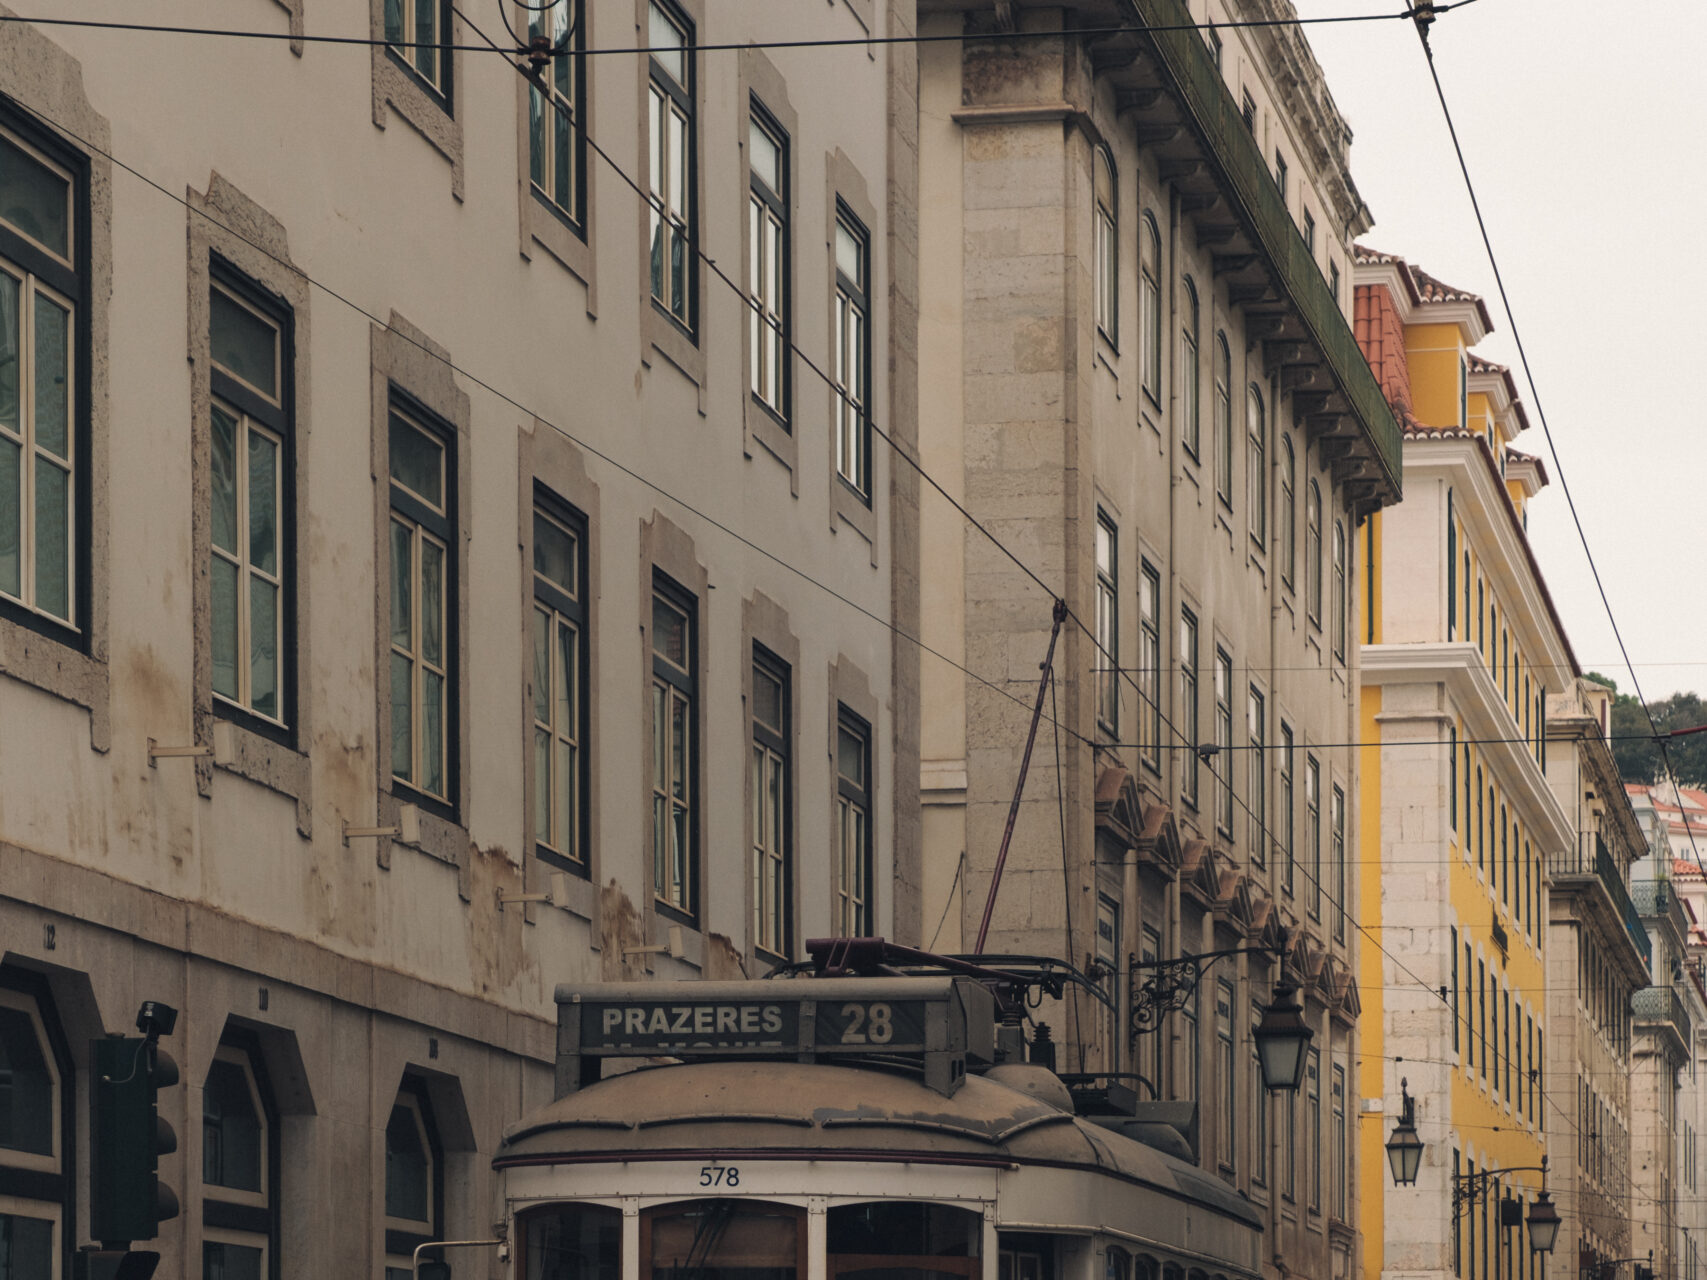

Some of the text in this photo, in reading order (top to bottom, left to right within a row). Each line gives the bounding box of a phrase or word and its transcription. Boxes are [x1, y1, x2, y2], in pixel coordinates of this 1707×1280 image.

[602, 1005, 783, 1036] PRAZERES
[840, 1002, 894, 1044] 28
[699, 1166, 740, 1187] 578
